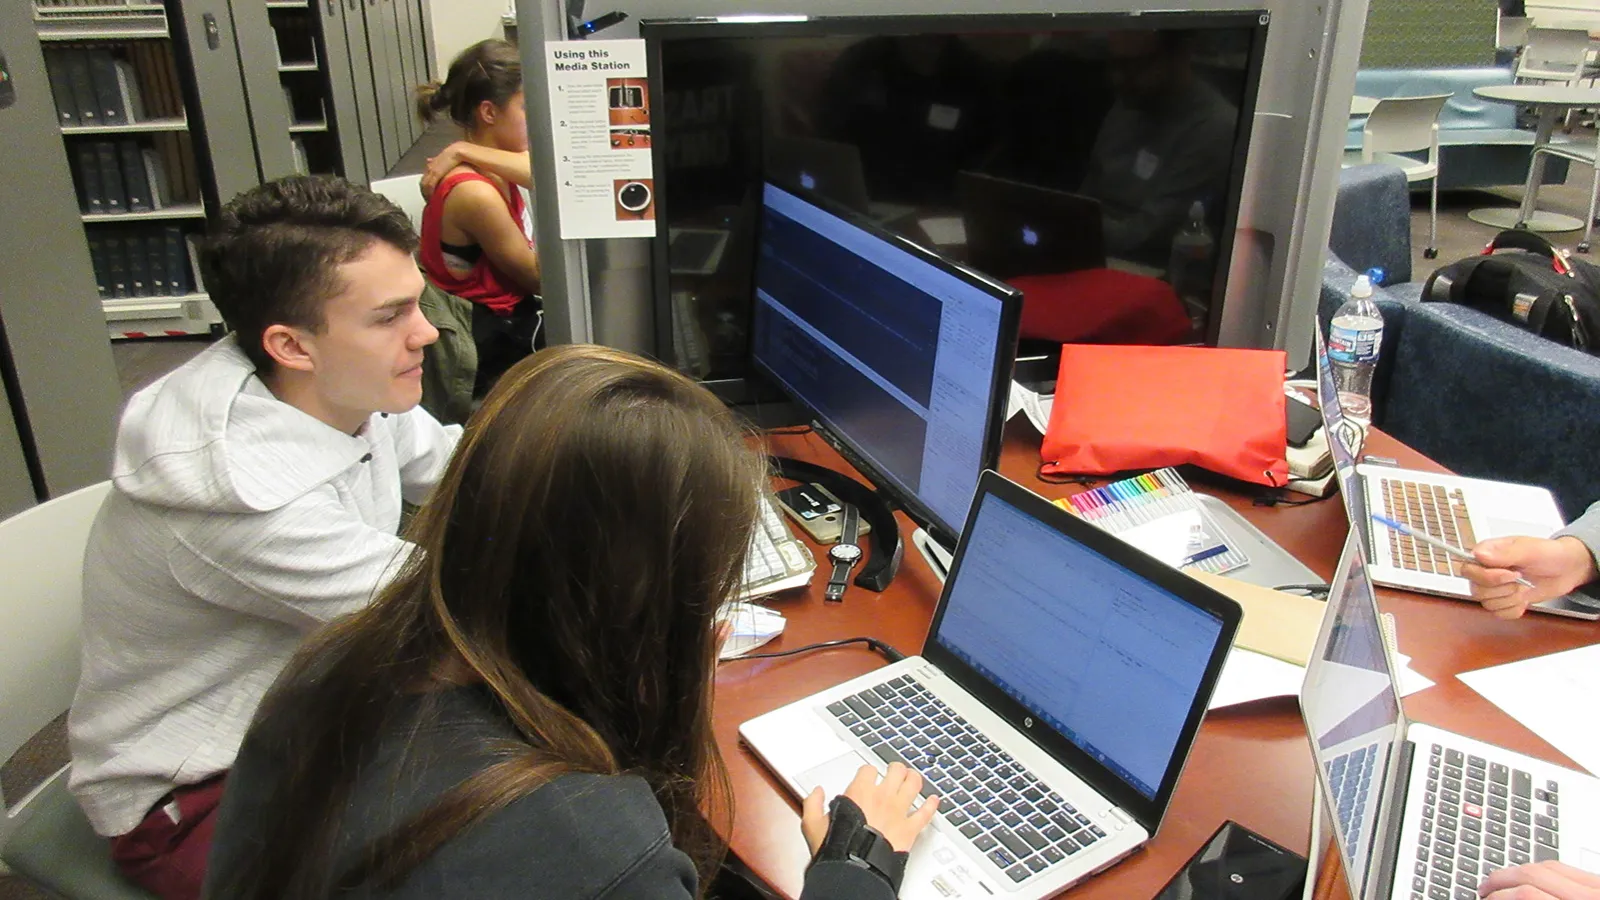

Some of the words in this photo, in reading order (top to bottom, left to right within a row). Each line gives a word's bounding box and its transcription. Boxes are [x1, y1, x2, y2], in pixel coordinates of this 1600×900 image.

[554, 50, 585, 60] Using
[589, 49, 609, 58] this
[555, 62, 588, 71] Media
[591, 61, 630, 70] Station
